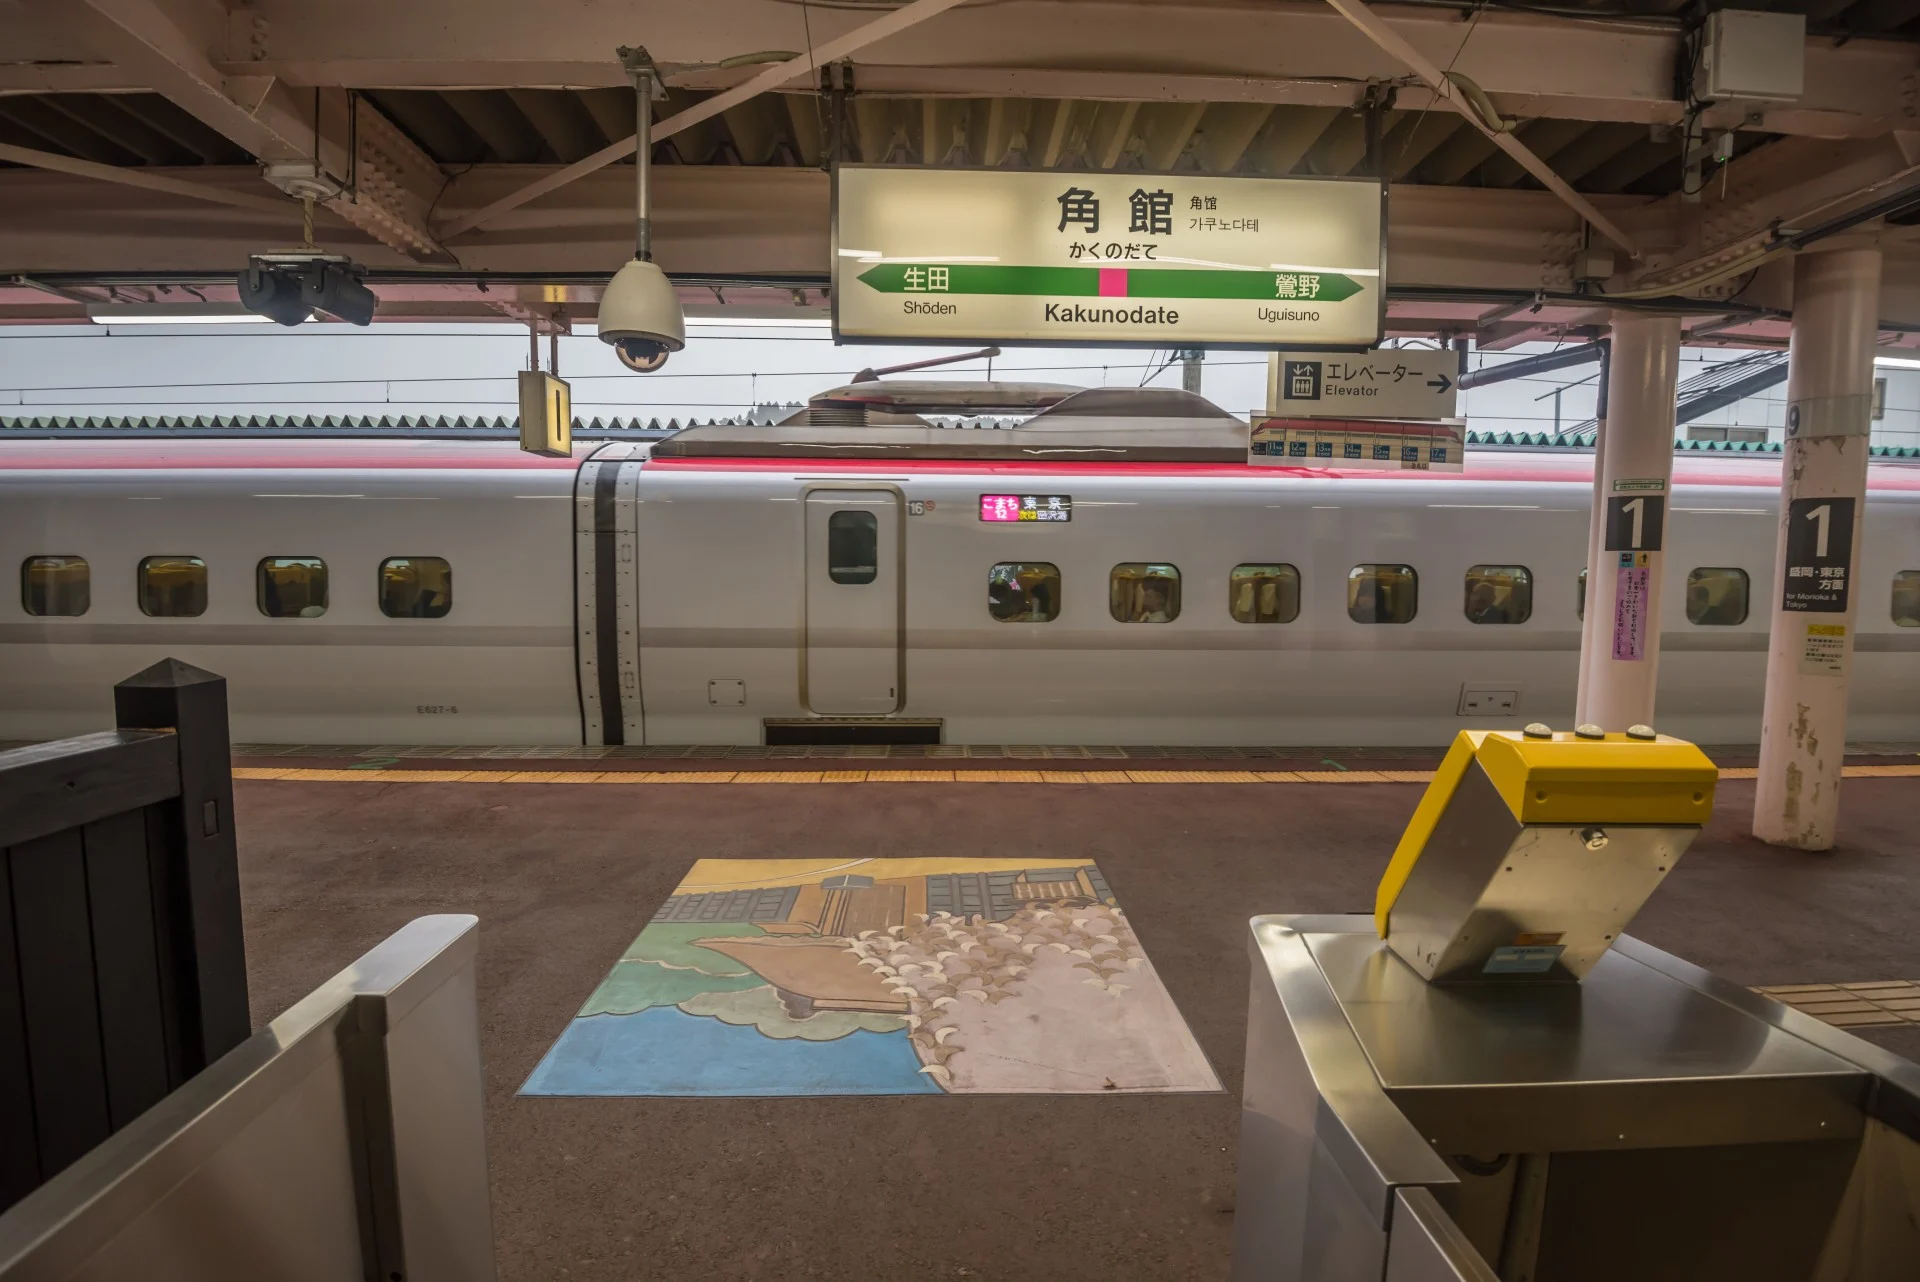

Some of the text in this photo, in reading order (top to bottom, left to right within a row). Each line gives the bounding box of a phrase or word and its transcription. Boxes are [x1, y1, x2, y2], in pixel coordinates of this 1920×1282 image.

[1056, 186, 1174, 235] 角館
[1189, 195, 1218, 211] 角馆
[1189, 217, 1260, 233] 가쿠노다테
[1069, 241, 1158, 260] かくのだて
[903, 266, 949, 292] 生田
[1274, 274, 1321, 299] 鶯野
[903, 301, 957, 315] Shōden
[1044, 303, 1180, 325] Kakunodate
[1257, 307, 1321, 323] Uguisuno
[1326, 363, 1424, 383] エレベーター
[1325, 384, 1379, 397] Elevator
[1788, 406, 1801, 437] 9
[910, 502, 924, 515] 16
[983, 497, 1019, 510] こまち
[1023, 496, 1062, 510] 東京
[994, 509, 1008, 520] 12
[1622, 498, 1644, 549] 1
[1805, 504, 1831, 557] 1
[1818, 579, 1845, 591] 方面
[1797, 593, 1830, 601] Morioka
[1786, 601, 1808, 610] Tokyo
